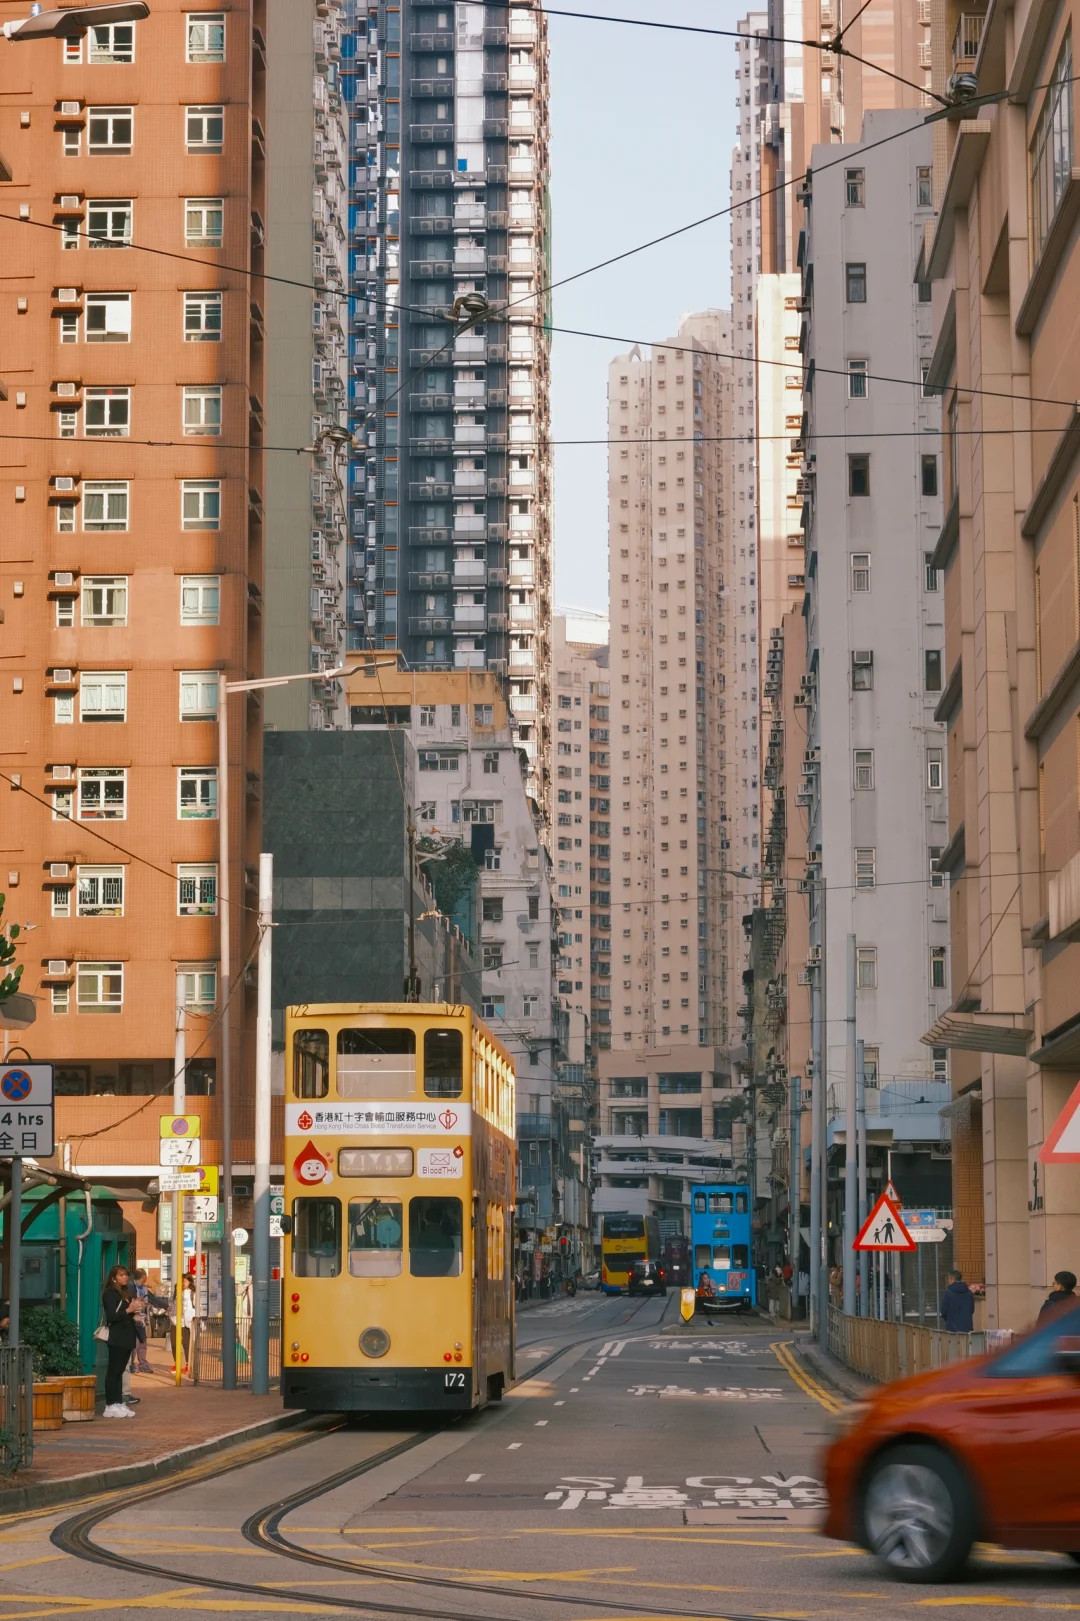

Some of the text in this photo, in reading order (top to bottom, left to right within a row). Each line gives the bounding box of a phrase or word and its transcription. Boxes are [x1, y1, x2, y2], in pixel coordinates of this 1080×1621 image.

[289, 1004, 309, 1018] 172
[445, 1005, 465, 1017] 172
[0, 1112, 44, 1126] 4 hrs
[315, 1112, 437, 1122] 香港紅十字會輸血服務中心
[0, 1131, 37, 1150] 全日
[186, 1140, 193, 1149] 7
[186, 1154, 193, 1164] 7
[204, 1197, 210, 1206] 7
[204, 1211, 215, 1220] 12
[445, 1373, 465, 1387] 172
